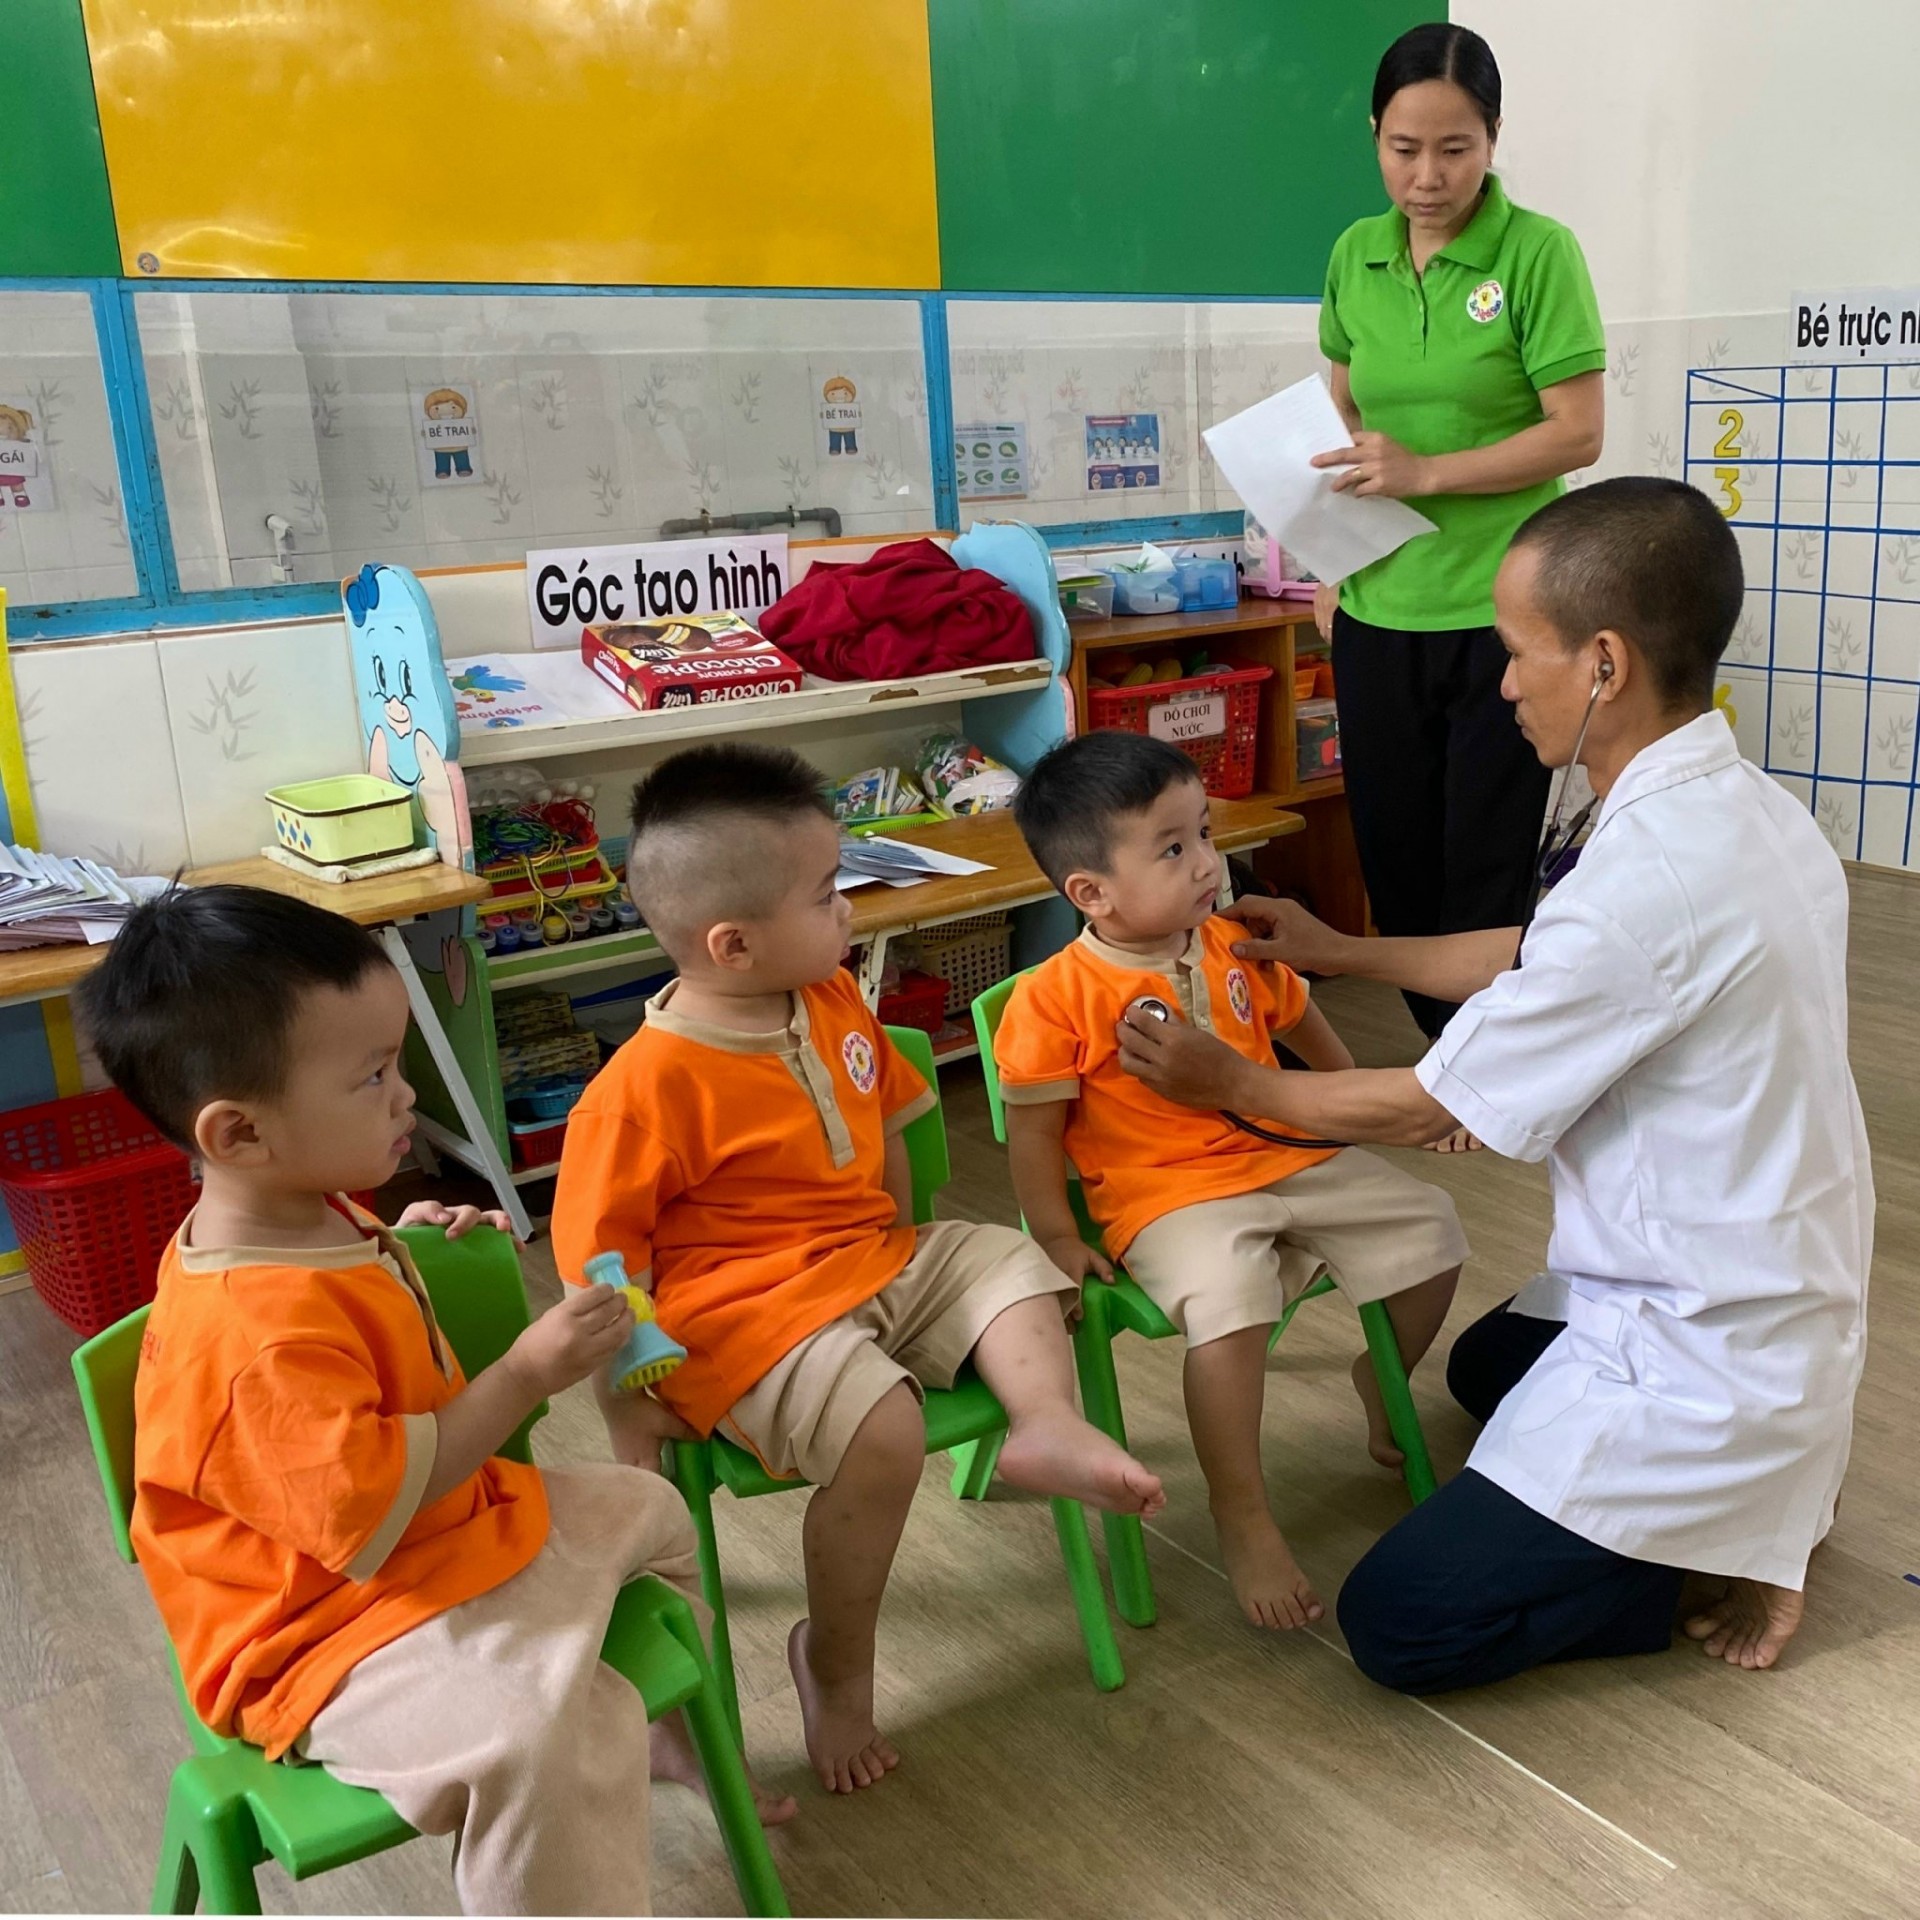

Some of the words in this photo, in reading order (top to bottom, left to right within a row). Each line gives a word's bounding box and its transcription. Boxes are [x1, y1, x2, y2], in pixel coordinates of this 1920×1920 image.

[1797, 302, 1829, 348] Bé
[1839, 303, 1892, 357] trực
[1900, 306, 1920, 344] n
[826, 408, 836, 419] BÉ
[838, 409, 857, 419] TRAI
[428, 424, 442, 438] BÉ
[444, 426, 469, 437] TRAI
[1714, 408, 1744, 458] 2
[0, 449, 25, 464] GÁI
[1715, 467, 1742, 518] 3
[536, 558, 625, 627] Góc
[708, 549, 783, 611] hình
[698, 668, 743, 680] ORION
